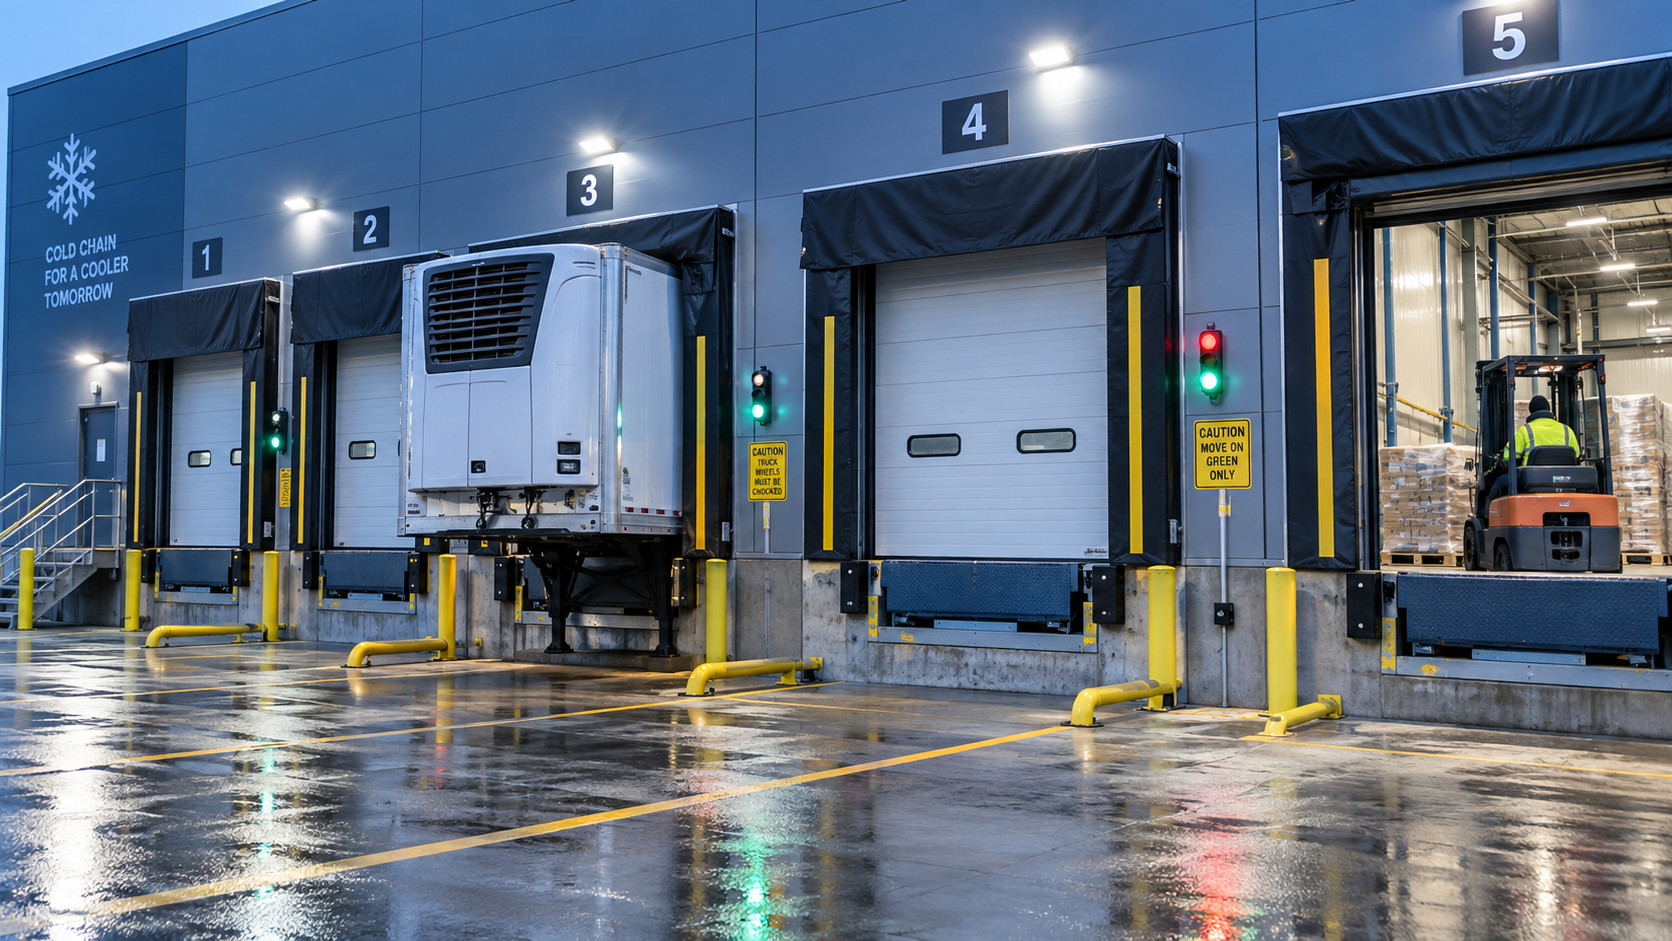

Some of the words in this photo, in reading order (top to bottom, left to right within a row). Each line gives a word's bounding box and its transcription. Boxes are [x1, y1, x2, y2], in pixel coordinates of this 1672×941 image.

[1492, 11, 1526, 60] 5
[961, 102, 987, 141] 4
[580, 173, 598, 207] 3
[363, 214, 377, 245] 2
[45, 242, 76, 263] COLD
[79, 233, 117, 256] CHAIN
[201, 244, 210, 271] 1
[44, 267, 67, 286] FOR
[69, 264, 78, 282] A
[80, 255, 129, 280] COOLER
[44, 281, 114, 309] TOMORROW
[1199, 426, 1245, 438] CAUTION
[752, 446, 784, 456] CAUTION
[1200, 442, 1227, 453] MOVE
[1230, 441, 1244, 452] ON
[757, 458, 778, 466] TRUCK
[1206, 455, 1238, 467] GREEN
[1210, 469, 1235, 480] ONLY
